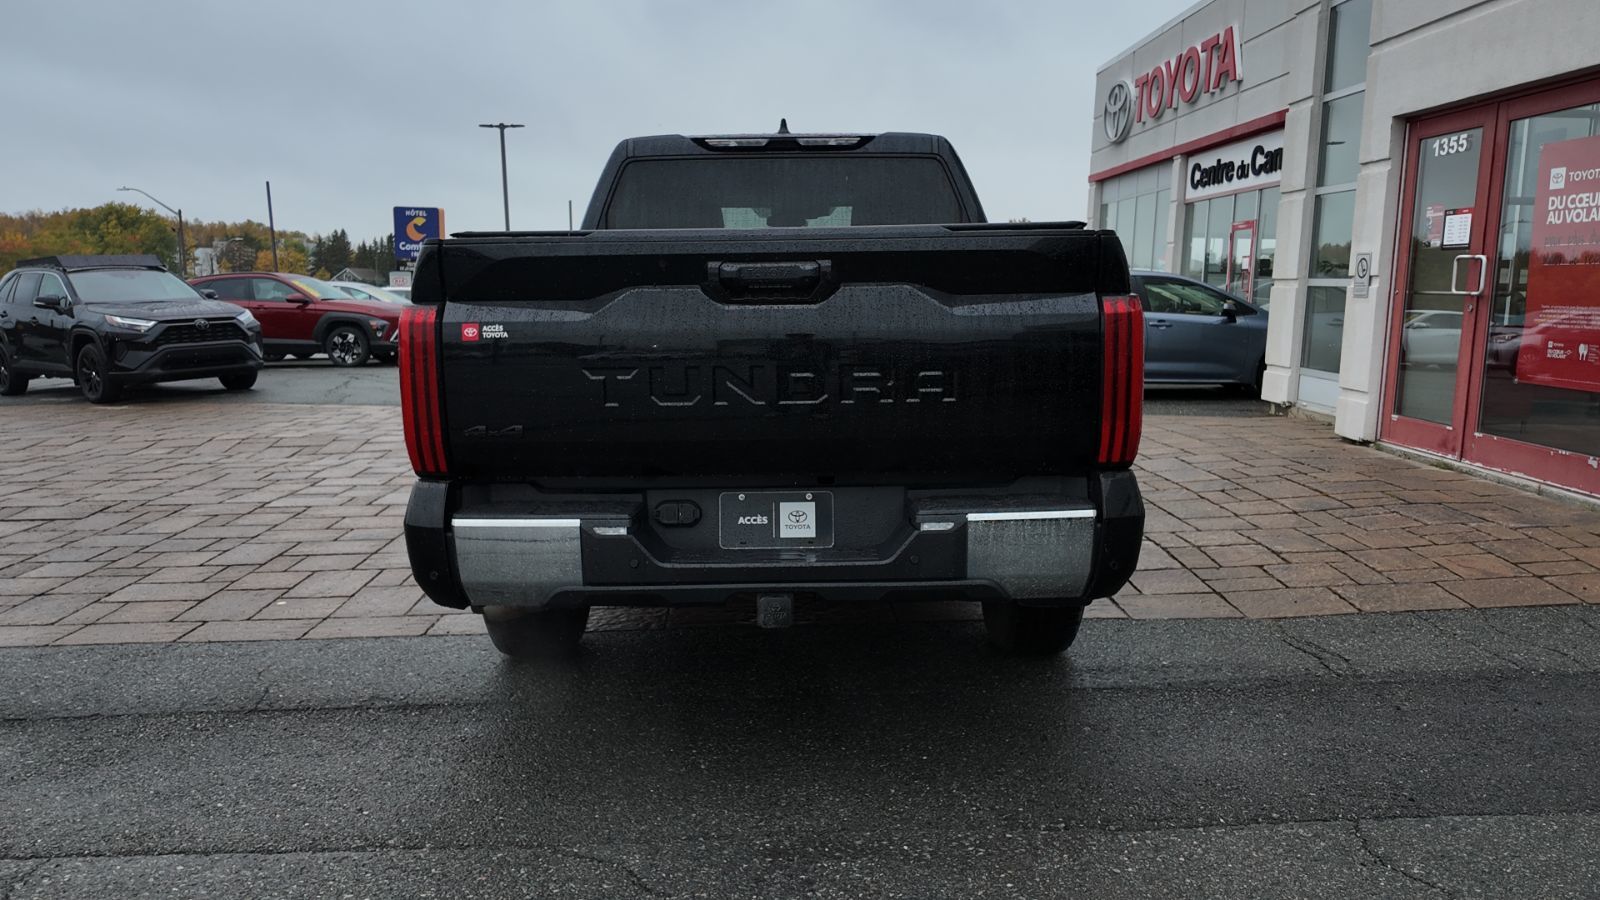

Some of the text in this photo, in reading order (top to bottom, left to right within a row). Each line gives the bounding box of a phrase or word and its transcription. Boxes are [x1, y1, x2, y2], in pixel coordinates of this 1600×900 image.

[1134, 25, 1241, 124] TOYOTA
[1433, 133, 1468, 157] 1355
[1190, 158, 1235, 190] Centre
[1236, 160, 1250, 180] du
[1568, 168, 1600, 182] TOYOT
[1548, 195, 1567, 211] DU
[405, 209, 427, 217] HÔTEL
[1546, 210, 1564, 225] AU
[399, 241, 423, 251] Comf
[482, 324, 504, 332] ACCÈS
[482, 331, 509, 339] TOYOTA
[581, 364, 957, 407] TUNDRA
[737, 514, 768, 526] ACCÈS
